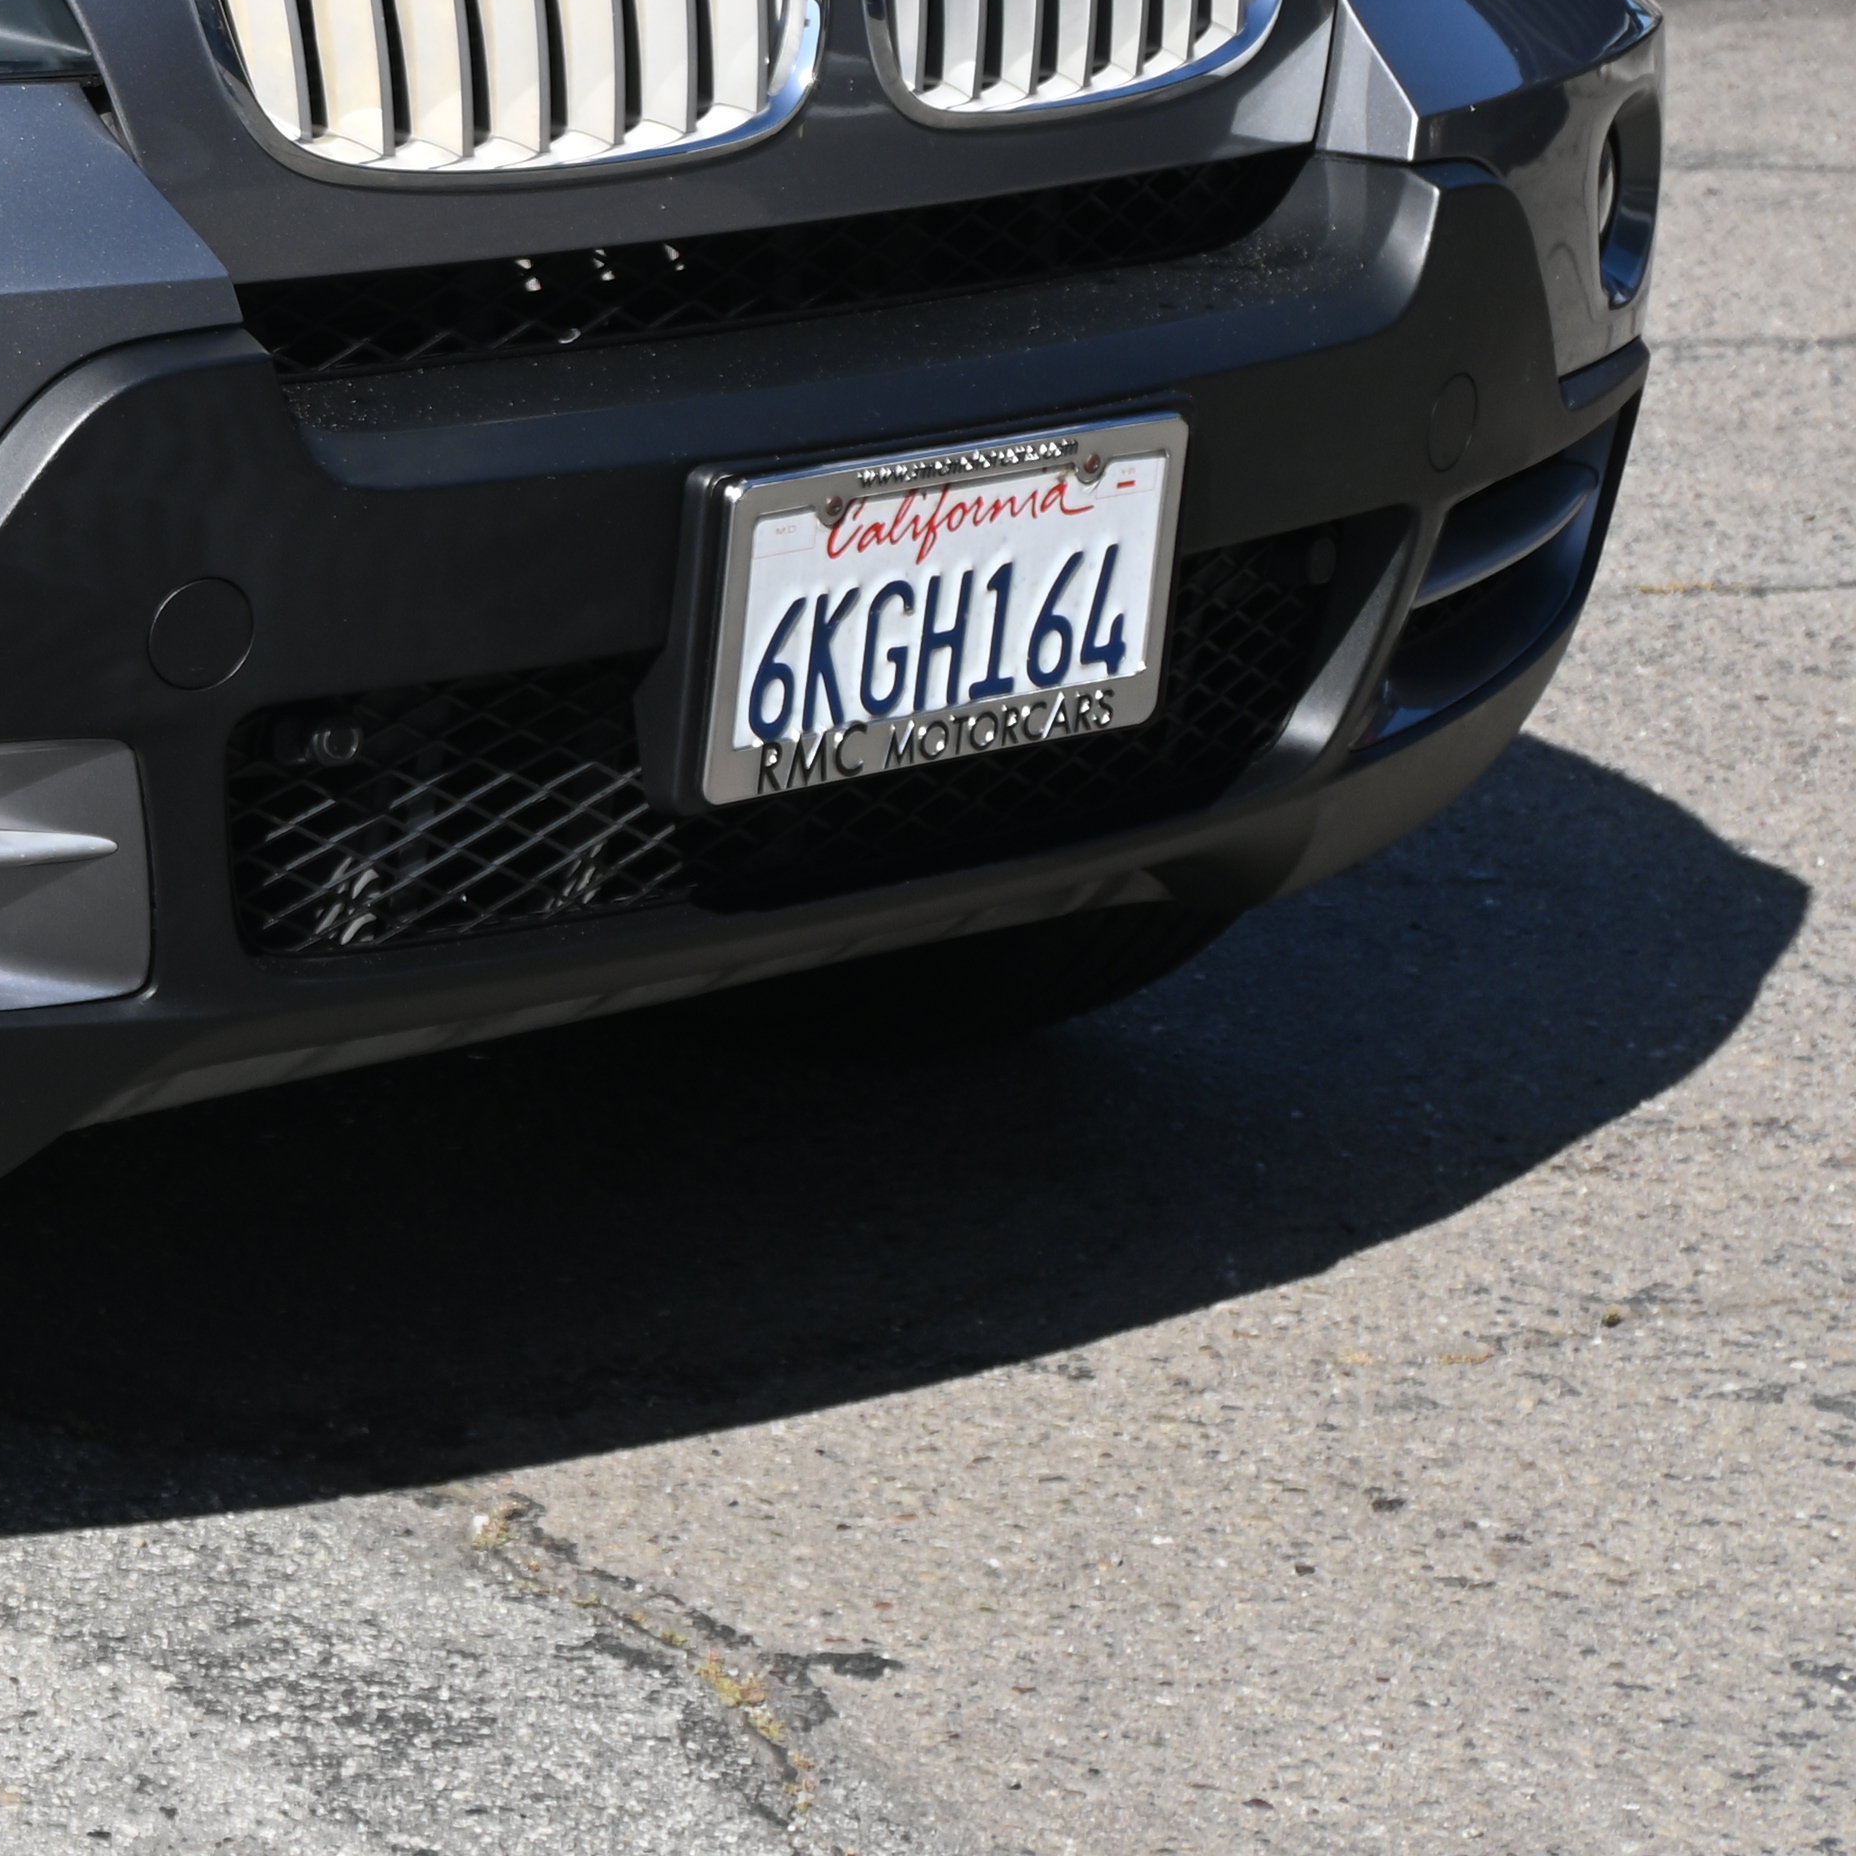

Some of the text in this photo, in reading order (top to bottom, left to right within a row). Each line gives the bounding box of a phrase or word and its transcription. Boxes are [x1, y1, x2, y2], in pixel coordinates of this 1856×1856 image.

[826, 481, 1095, 565] California
[747, 542, 1127, 742] 6KGH164
[755, 688, 1116, 795] RMC MOTORCARS
